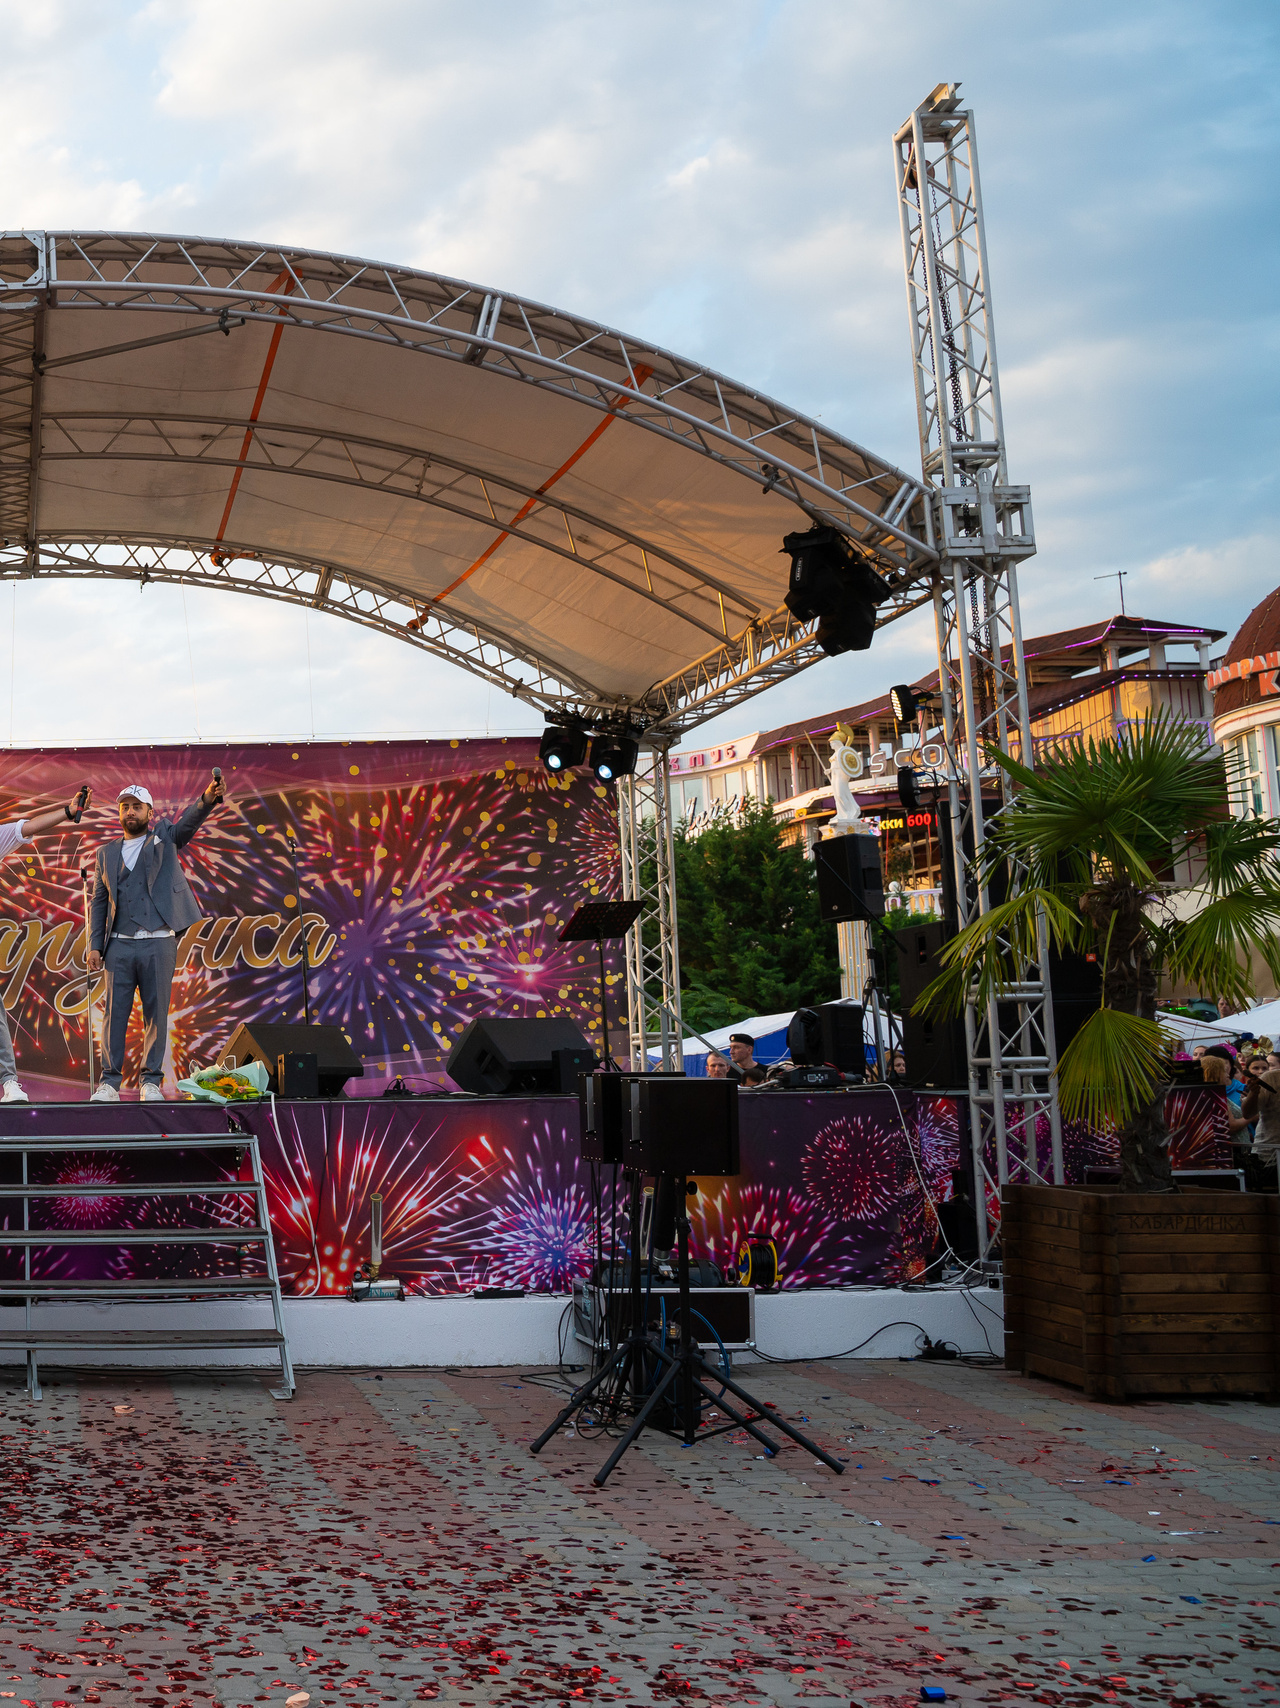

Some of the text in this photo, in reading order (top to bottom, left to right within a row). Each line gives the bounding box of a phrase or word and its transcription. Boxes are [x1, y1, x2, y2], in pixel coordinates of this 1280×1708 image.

[870, 744, 944, 774] SCO
[907, 813, 932, 827] 600
[1129, 1214, 1246, 1232] КАБАРДИНКА
